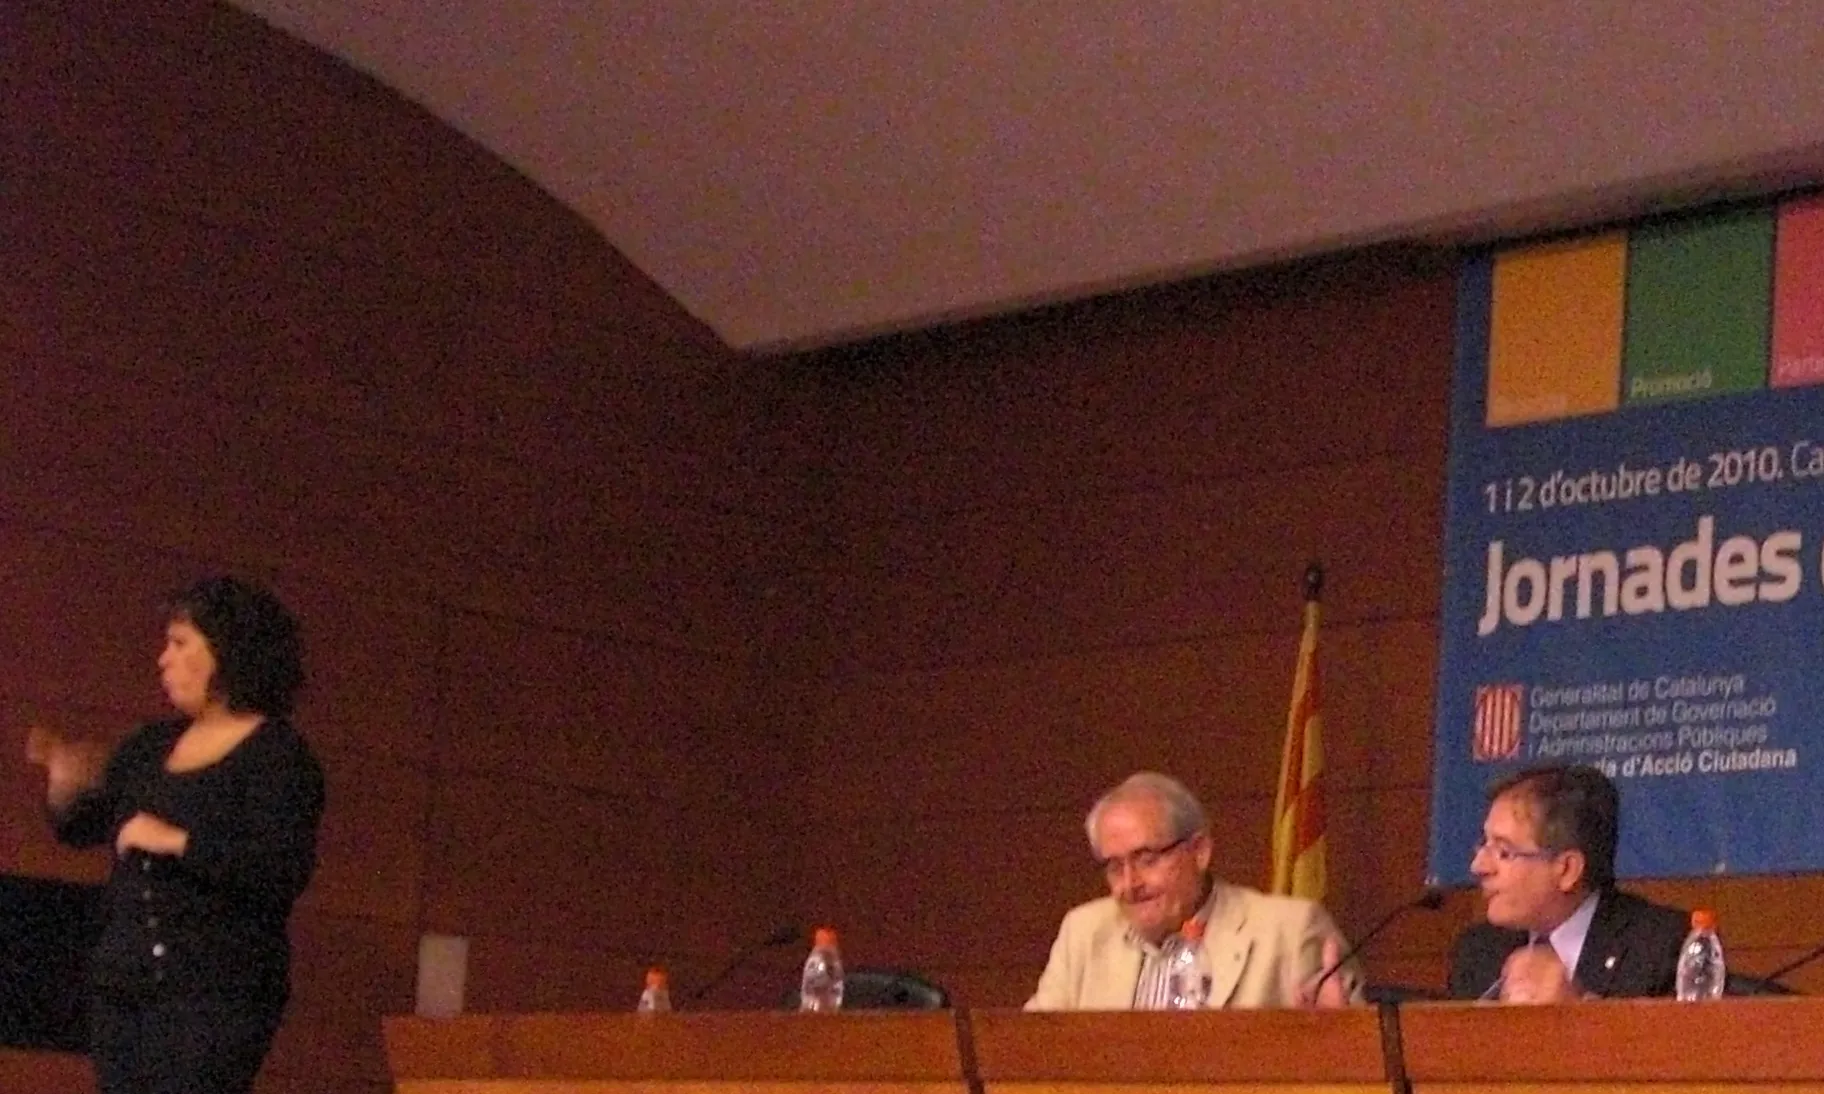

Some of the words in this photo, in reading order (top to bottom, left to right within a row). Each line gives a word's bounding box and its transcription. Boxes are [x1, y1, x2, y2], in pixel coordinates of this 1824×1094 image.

[1484, 485, 1496, 512] 1
[1516, 480, 1533, 510] 2
[1539, 463, 1660, 507] d'octubre
[1667, 457, 1701, 491] de
[1707, 448, 1783, 488] 2010.
[1477, 517, 1803, 636] Jornades
[1530, 681, 1623, 708] Generalitat
[1628, 680, 1649, 701] de
[1654, 674, 1744, 697] Catalunya
[1529, 708, 1640, 734] Departament
[1644, 703, 1667, 724] de
[1672, 697, 1777, 724] Governació
[1537, 731, 1674, 757] Administracions
[1677, 724, 1768, 750] Públiques
[1621, 754, 1693, 778] d'Acció
[1698, 748, 1797, 774] Ciutadana
